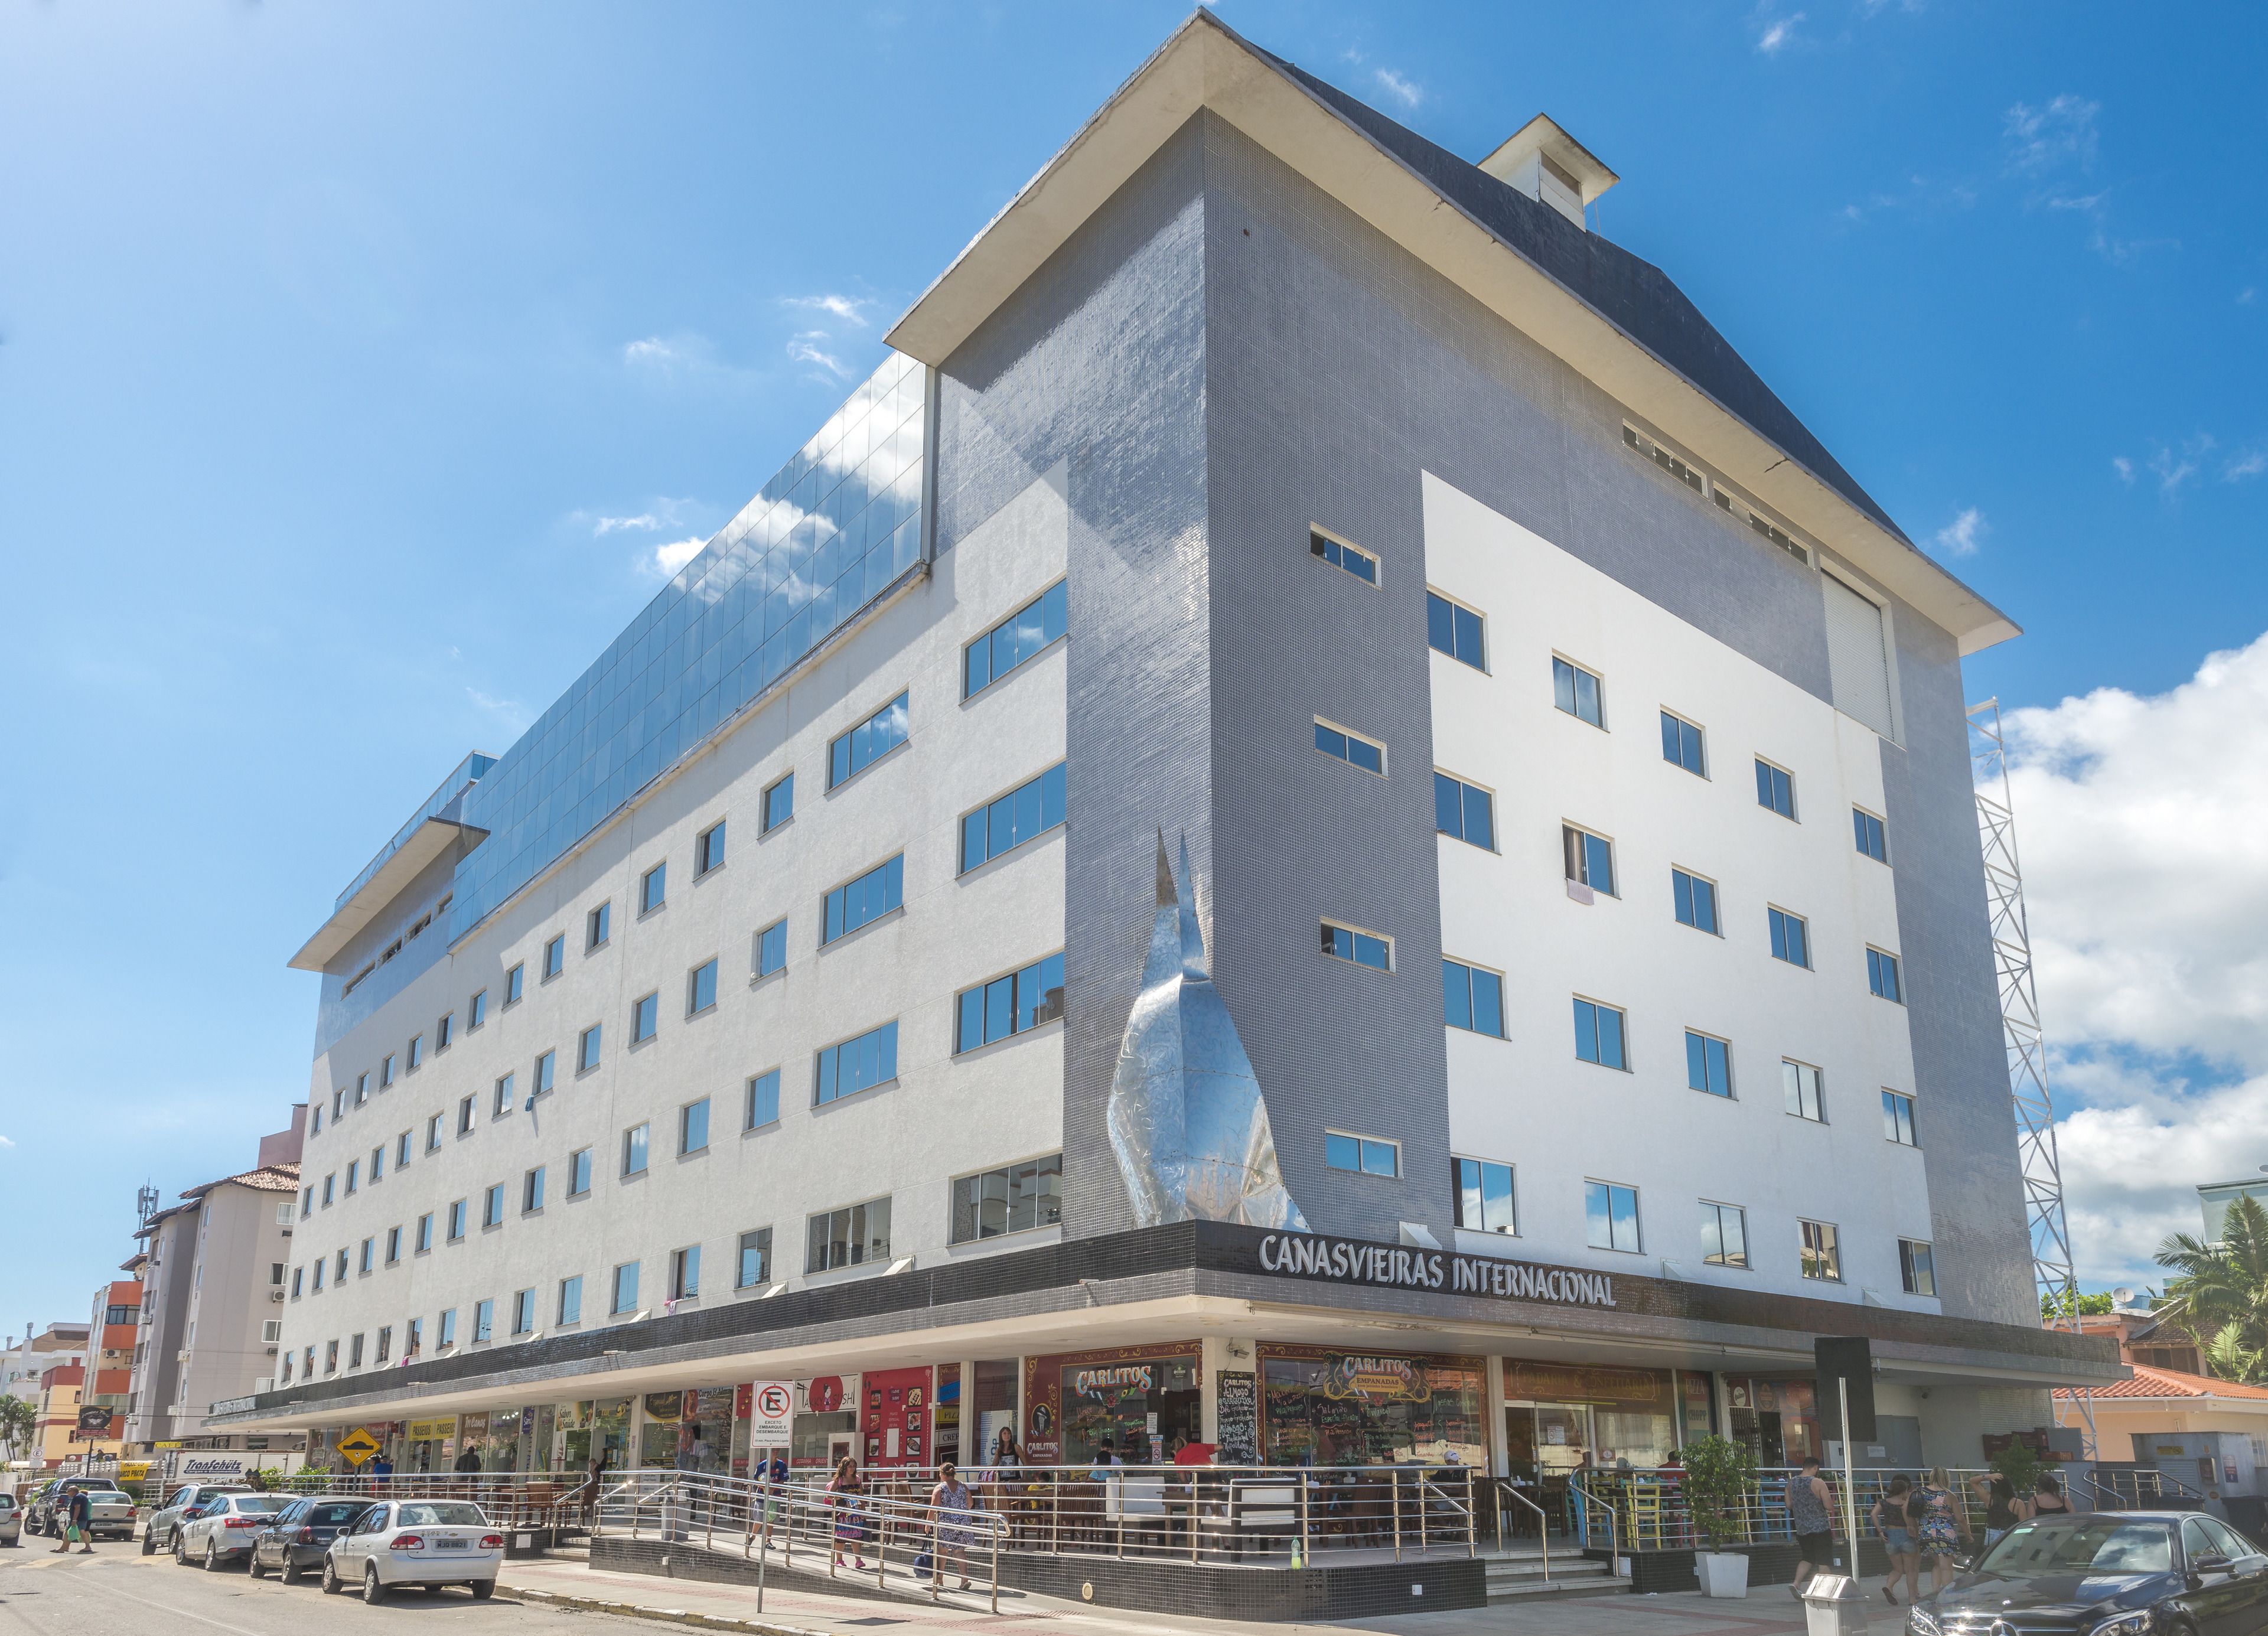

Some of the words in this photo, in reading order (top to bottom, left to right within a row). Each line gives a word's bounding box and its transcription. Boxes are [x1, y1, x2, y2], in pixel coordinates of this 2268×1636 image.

[1259, 1235, 1443, 1288] CANASVIEIRAS
[1451, 1257, 1617, 1306] INTERNACIONAL
[1342, 1357, 1412, 1381] CARLITOS
[1076, 1365, 1152, 1397] CARLITOS
[1224, 1379, 1252, 1388] CARLITOS
[1524, 1371, 1568, 1386] PADARIA
[1586, 1375, 1652, 1390] CONFEITARIA
[1686, 1378, 1705, 1394] PIZZA
[699, 1389, 712, 1399] Corpo
[832, 1378, 856, 1407] SUSHI
[559, 1409, 571, 1418] Sabor
[1687, 1409, 1707, 1421] CHOPP
[413, 1424, 431, 1436] PASSEIOS
[562, 1419, 575, 1429] Saúde
[1027, 1442, 1058, 1454] CARLITOS
